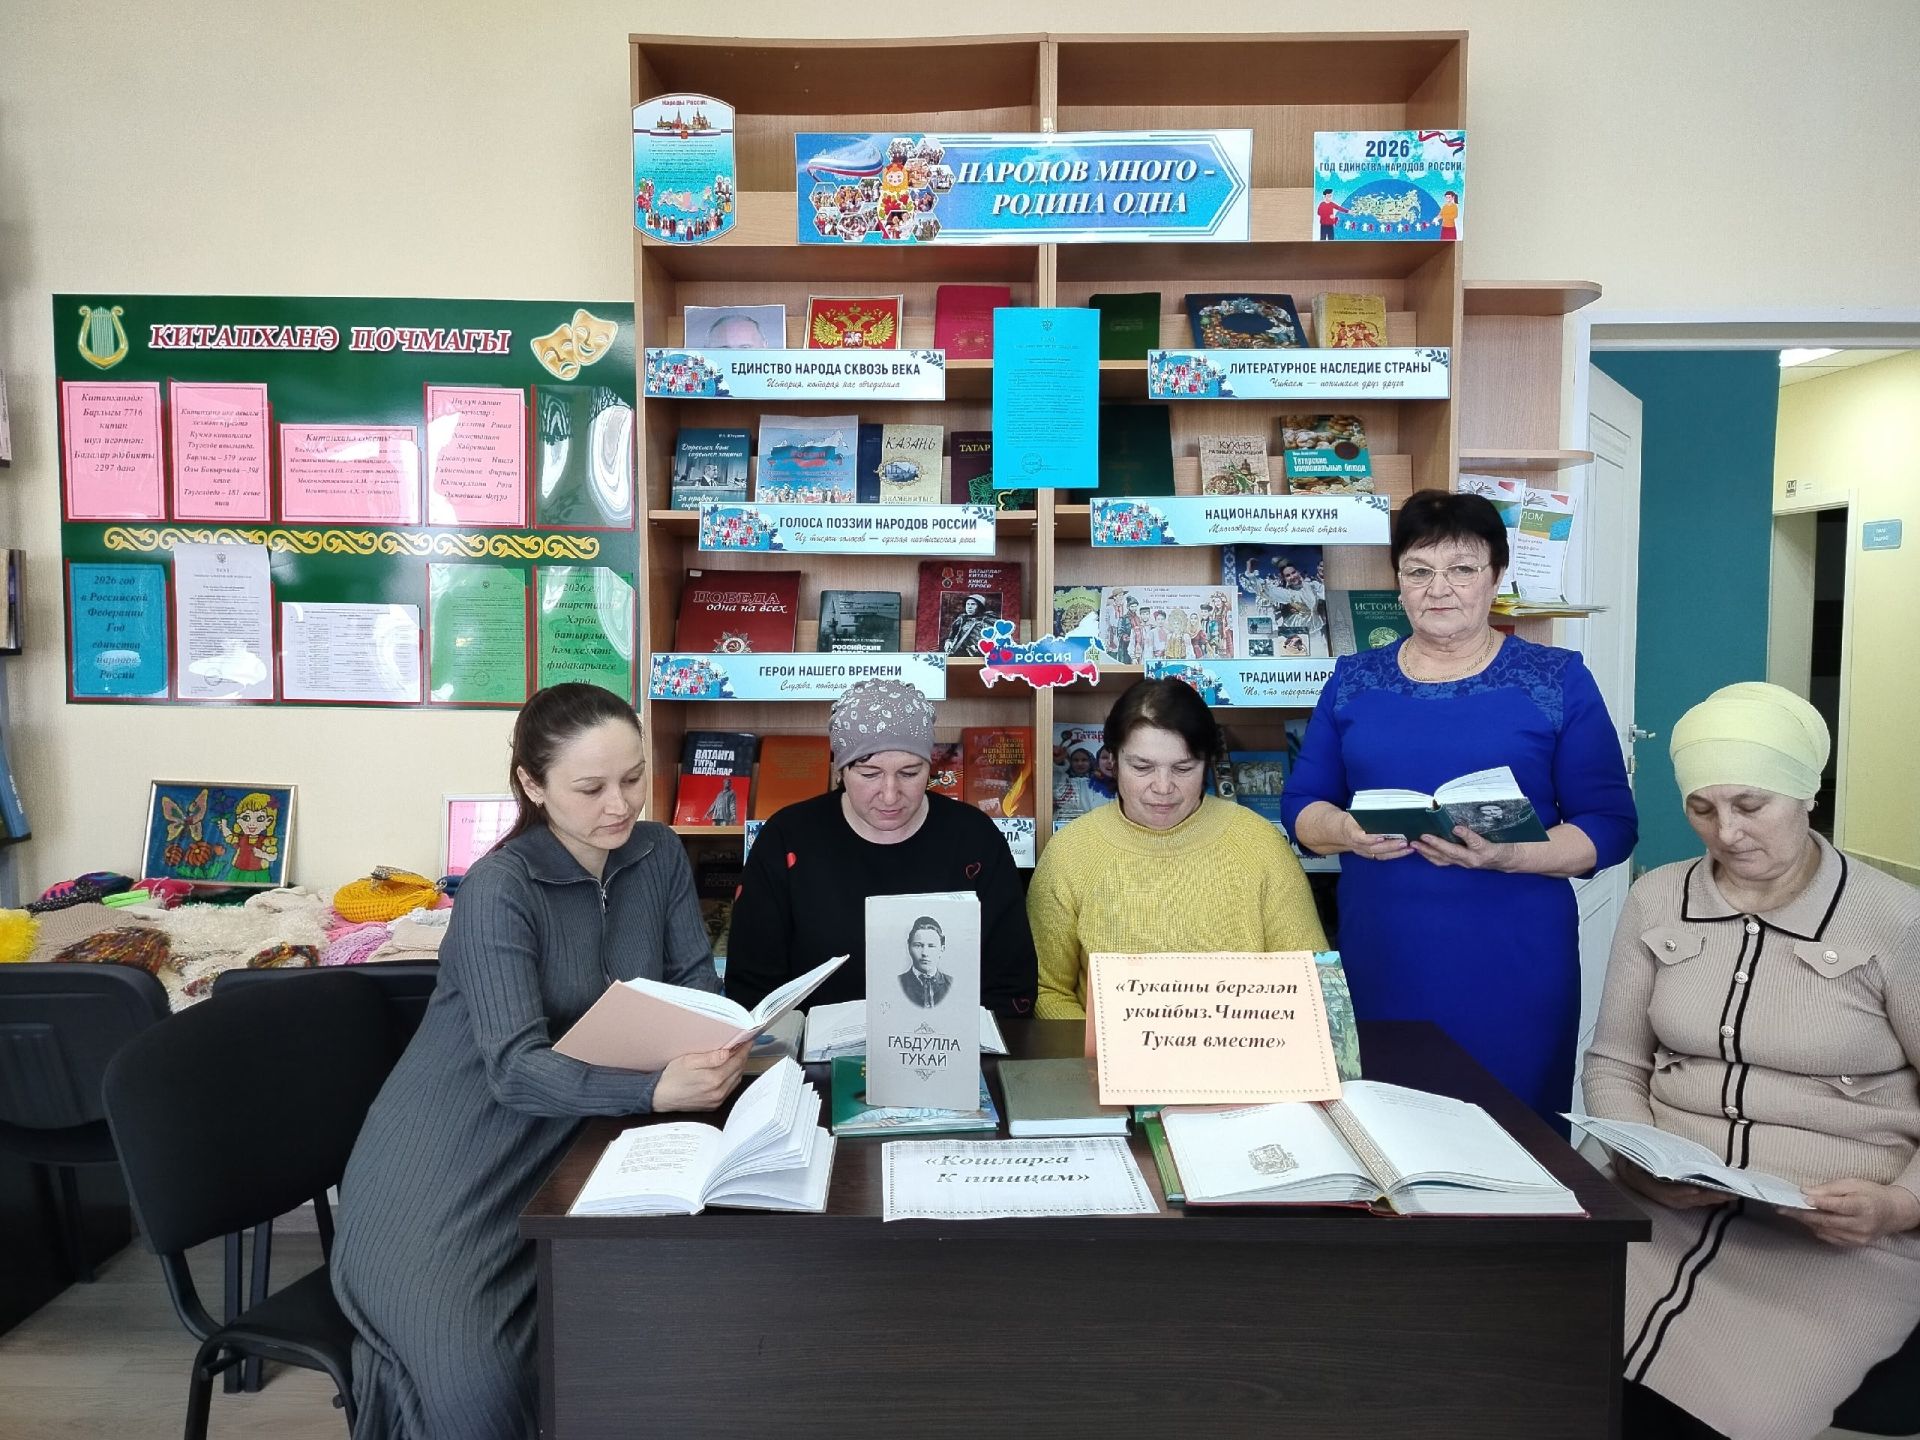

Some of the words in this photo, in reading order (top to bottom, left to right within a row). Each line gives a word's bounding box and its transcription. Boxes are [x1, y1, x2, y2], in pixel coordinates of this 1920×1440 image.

[1366, 140, 1410, 158] 2026
[956, 160, 1087, 185] НАРОДОВ
[1094, 159, 1198, 183] МНОГО
[1319, 163, 1336, 172] ГОД
[1339, 163, 1382, 172] ЕДИНСТВА
[1385, 162, 1424, 172] НАРОДОВ
[1428, 162, 1462, 171] РОССИИ
[992, 194, 1105, 217] РОДИНА
[1113, 192, 1187, 214] ОДНА
[149, 325, 339, 350] КИТАПХАНӘ
[350, 327, 511, 353] ПОЧМАГЫ
[731, 363, 792, 375] ЕДИНСТВО
[795, 363, 841, 376] НАРОДА
[844, 363, 888, 375] СКВОЗЬ
[892, 364, 920, 375] ВЕКА
[1229, 362, 1317, 374] ЛИТЕРАТУРНОЕ
[1320, 362, 1381, 374] НАСЛЕДИЕ
[1385, 362, 1431, 373] СТРАНЫ
[767, 378, 803, 391] История,
[807, 381, 840, 390] которая
[1269, 378, 1303, 388] Читаем
[1362, 380, 1380, 390] друг
[1382, 380, 1404, 390] друга
[124, 408, 143, 416] 7716
[886, 437, 936, 450] КАЗАНЬ
[959, 444, 991, 452] ТАТАР
[1219, 441, 1251, 450] КУХНЯ
[94, 464, 114, 472] 2297
[1205, 508, 1298, 520] НАЦИОНАЛЬНАЯ
[1301, 508, 1338, 520] КУХНЯ
[780, 517, 823, 528] ГОЛОСА
[827, 518, 872, 529] ПОЭЗИИ
[875, 518, 928, 530] НАРОДОВ
[932, 518, 977, 529] РОССИИ
[1208, 523, 1261, 534] Многообразие
[794, 532, 806, 544] Из
[94, 576, 117, 585] 2026
[119, 576, 136, 585] год
[563, 584, 586, 593] 2026
[89, 592, 148, 602] Российской
[693, 591, 780, 604] ПОБЕДА
[88, 608, 144, 618] Федерации
[706, 603, 736, 612] одна
[740, 605, 756, 613] на
[759, 604, 788, 614] всех
[106, 623, 125, 633] Год
[92, 641, 141, 649] единства
[1015, 652, 1072, 663] РОССИЯ
[100, 670, 135, 680] России
[759, 666, 795, 677] ГЕРОИ
[799, 666, 845, 676] НАШЕГО
[849, 666, 902, 676] ВРЕМЕНИ
[1239, 672, 1301, 684] ТРАДИЦИИ
[1305, 671, 1333, 683] НАРО
[1243, 686, 1260, 696] То,
[1280, 688, 1322, 698] передаётс
[1074, 732, 1104, 742] Татар
[695, 749, 735, 761] ВАТАНГА
[1115, 978, 1209, 996] «Тукайны
[1216, 979, 1298, 997] бергәләп
[888, 1036, 960, 1051] ГАБДУЛЛА
[1141, 1031, 1197, 1050] Тукая
[1203, 1034, 1286, 1049] вместе»
[899, 1052, 947, 1067] ТУКАЙ
[925, 1154, 1069, 1166] «Кошларга
[936, 1173, 953, 1183] К
[964, 1173, 1091, 1184] птицам»
